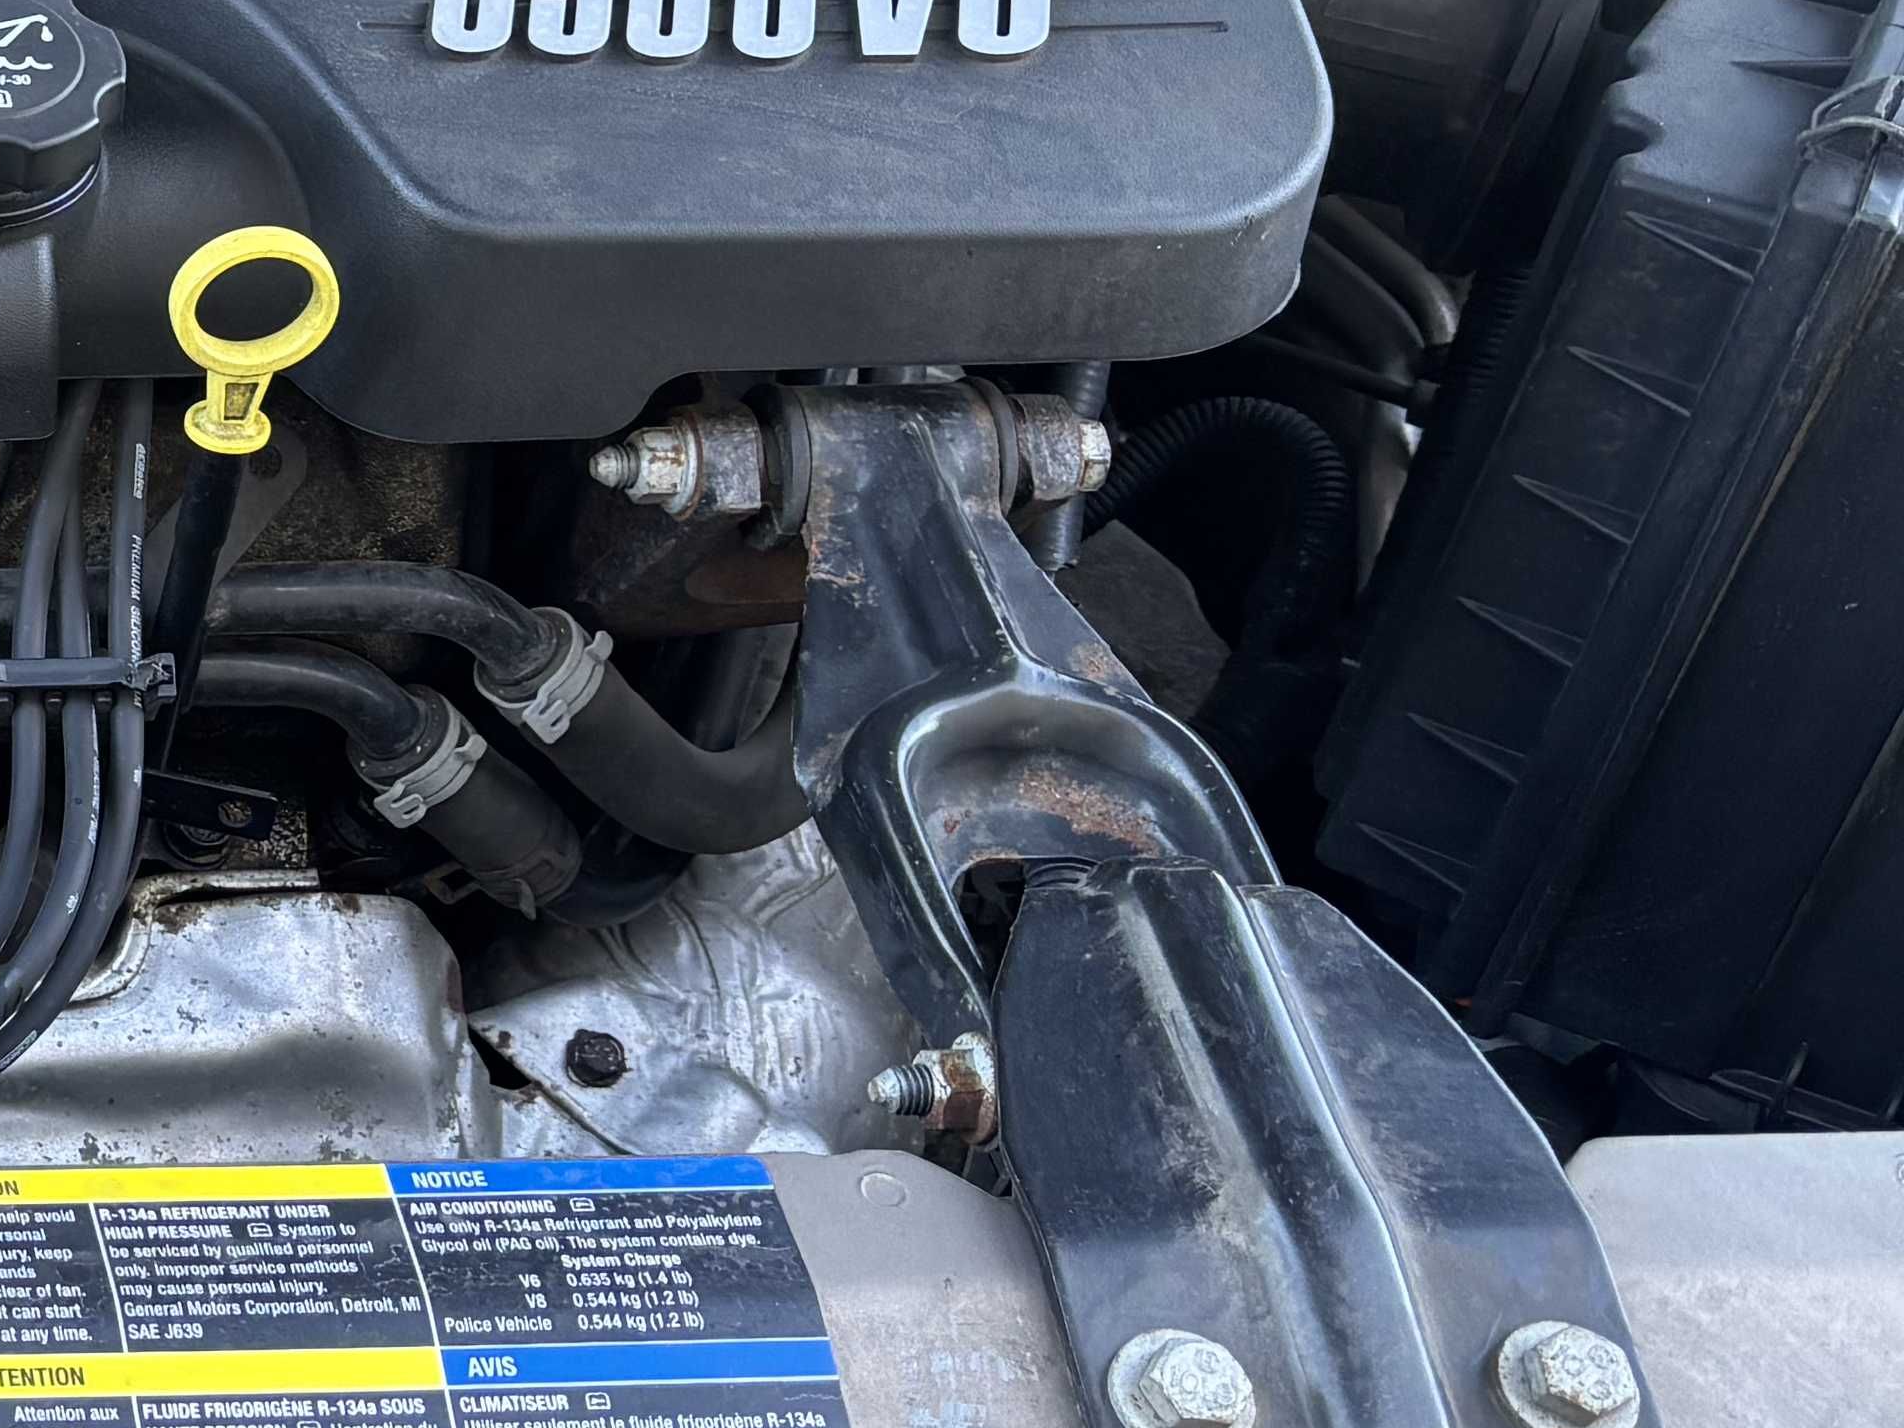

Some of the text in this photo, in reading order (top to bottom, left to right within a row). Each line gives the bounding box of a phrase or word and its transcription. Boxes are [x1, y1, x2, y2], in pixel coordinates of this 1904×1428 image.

[130, 534, 143, 601] PREMIUM
[412, 1171, 488, 1188] NOTICE
[161, 1206, 269, 1220] REFRIGERANT
[274, 1205, 330, 1218] UNDER
[561, 1253, 681, 1270] System Charge
[519, 1271, 692, 1288] V6 0.635 kg (1.4 lb)
[124, 1302, 183, 1317] General
[187, 1301, 241, 1315] Motors
[245, 1299, 339, 1317] Corporation,
[401, 1297, 421, 1311] MI
[525, 1290, 698, 1309] V8 0.544 kg (1.2 lb)
[445, 1312, 704, 1332] Police Vehicle 0.544 kg (1.2 lb)
[128, 1323, 203, 1339] SAE J639
[469, 1356, 517, 1377] AVIS
[143, 1398, 425, 1419] FLUIDE FRIGORIGÈNE R-134a SOUS
[460, 1395, 569, 1412] CLIMATISEUR
[15, 1405, 119, 1422] Attention aux
[767, 1412, 825, 1428] R-134a
